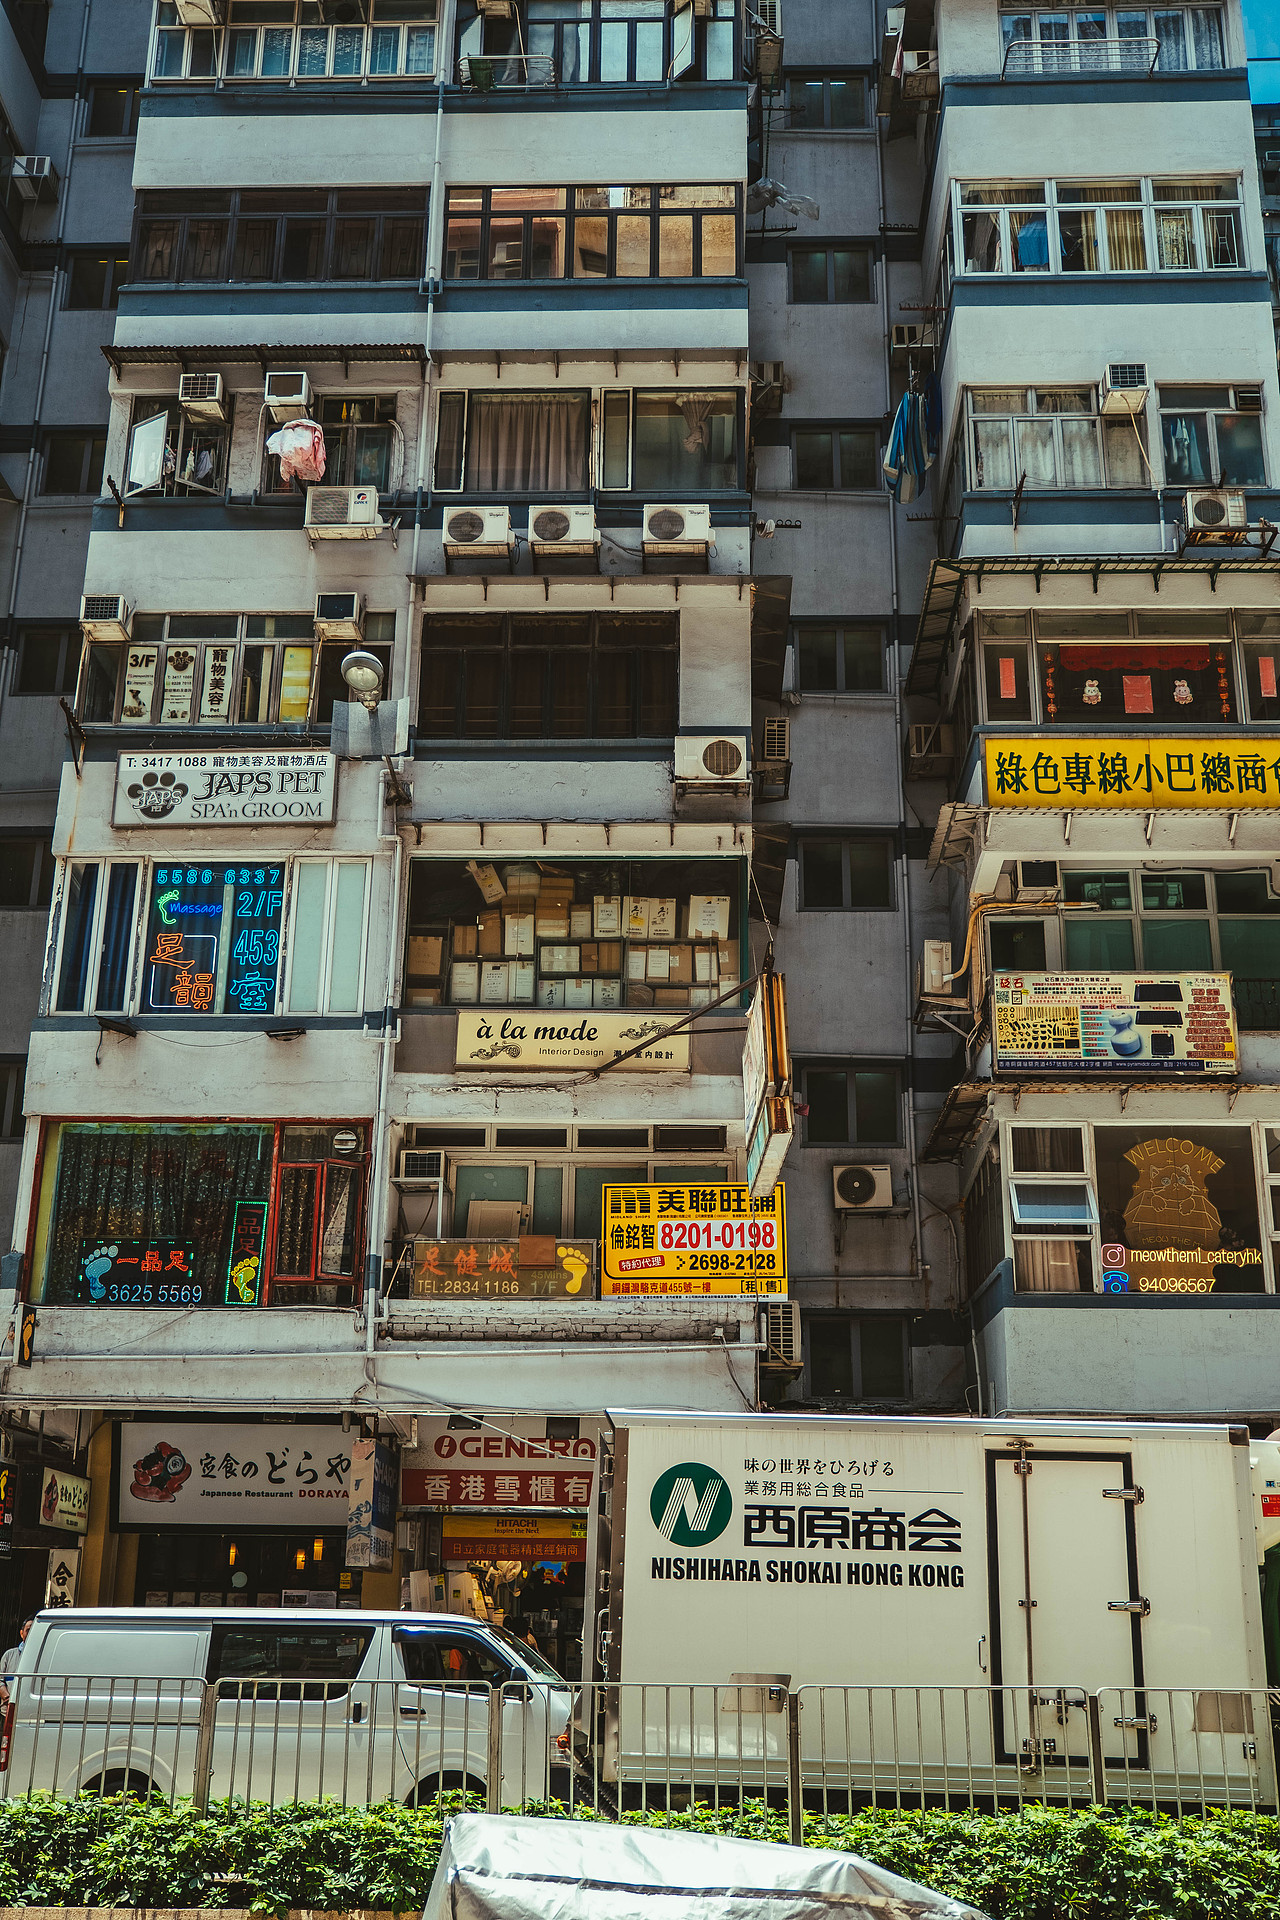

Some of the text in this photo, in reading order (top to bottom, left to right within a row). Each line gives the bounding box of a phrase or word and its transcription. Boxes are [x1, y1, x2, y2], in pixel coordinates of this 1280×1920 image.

[129, 654, 156, 667] 3/F
[208, 649, 228, 705] 寵物美容
[126, 757, 207, 768] T: 3417 1088
[212, 755, 328, 767] 寵物美容及寵物酒店
[191, 771, 326, 801] JAPS PET
[132, 789, 184, 810] JAPS
[242, 802, 323, 818] GROOM
[157, 869, 280, 884] 5586 6337
[169, 903, 223, 917] Massage
[237, 891, 283, 916] 2/F
[234, 930, 279, 966] 453
[476, 1018, 599, 1041] à la mode
[539, 1047, 604, 1057] Interior Design
[613, 1049, 674, 1060] 潮室內設計
[1123, 1138, 1226, 1174] WELCOME
[234, 1209, 264, 1255] 一品足
[610, 1224, 655, 1250] 倫銘智
[660, 1222, 775, 1249] 8201-0198
[117, 1250, 189, 1272] 一品足
[621, 1256, 663, 1271] 特約代理
[689, 1253, 776, 1270] 2698-2128
[108, 1285, 202, 1302] 3625 5569
[484, 1280, 519, 1294] 1186
[530, 1281, 558, 1294] 1/F
[611, 1281, 712, 1294] 銅鑼灣駱克道455號一樓
[1139, 1277, 1216, 1293] 94096567
[743, 1458, 895, 1477] 味の世界をひろげる
[200, 1489, 243, 1499] Japanese
[245, 1489, 294, 1498] Restaurant
[424, 1474, 590, 1503] 香港雪櫃有
[743, 1480, 865, 1499] 業務用総合食品
[494, 1527, 513, 1535] Inspire
[496, 1518, 538, 1528] HITACHI
[743, 1503, 962, 1553] 西原商会
[452, 1543, 579, 1557] 日立家庭電器精選經銷商
[651, 1556, 965, 1588] NISHIHARA SHOKAI HONG KONG
